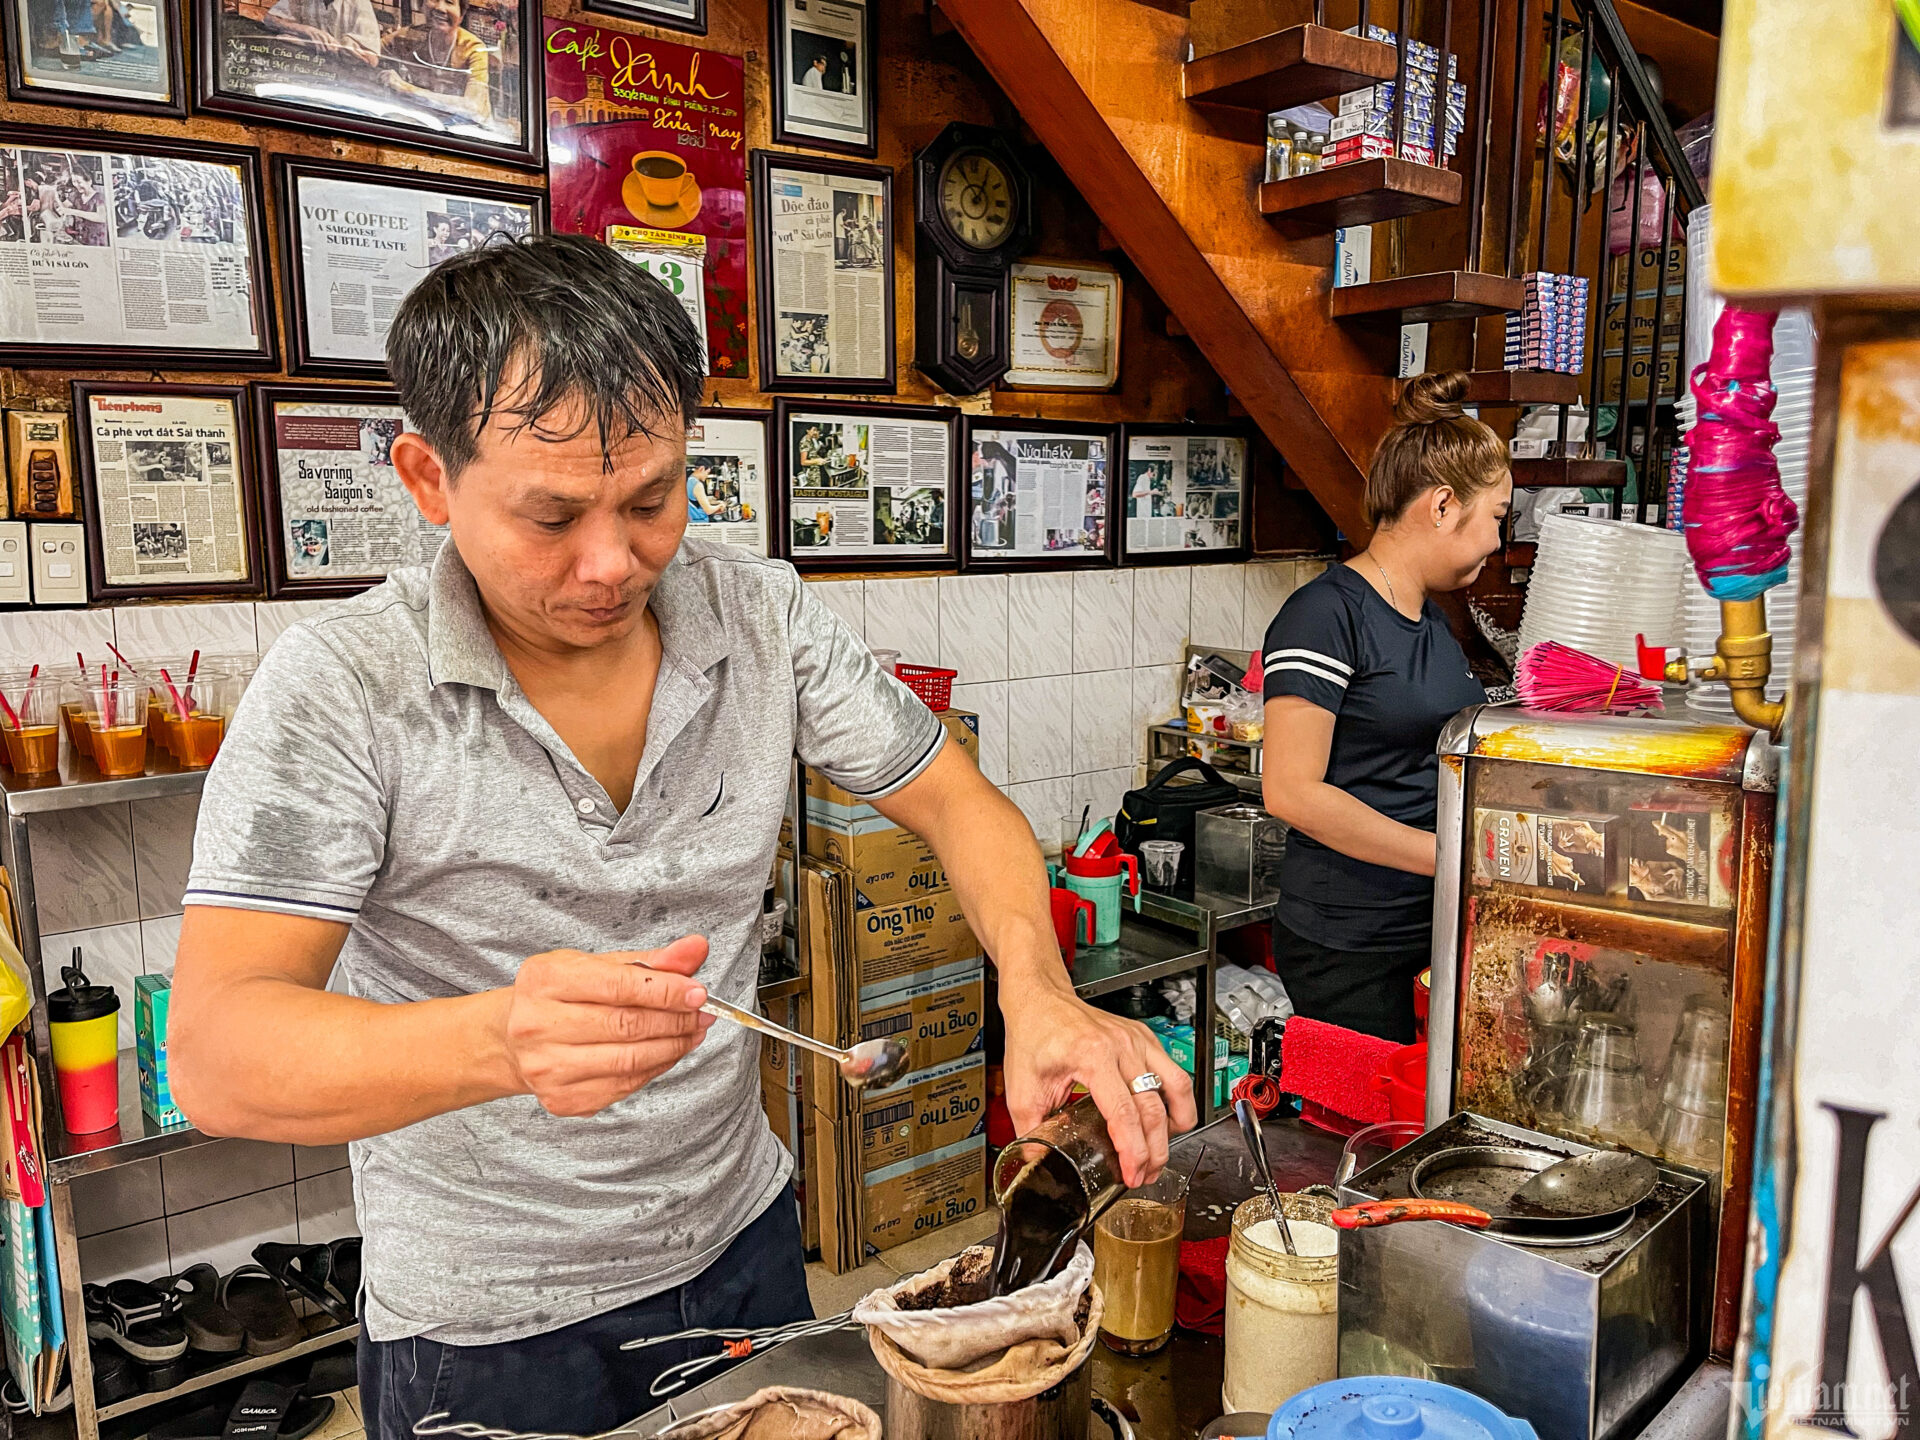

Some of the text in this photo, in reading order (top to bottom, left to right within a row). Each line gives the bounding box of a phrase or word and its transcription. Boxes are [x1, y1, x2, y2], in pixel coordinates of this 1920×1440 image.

[546, 27, 606, 71] Café
[326, 224, 377, 237] SAIGONESE
[344, 211, 409, 230] COFFEE
[326, 235, 407, 251] SUBTLE TASTE
[298, 459, 354, 485] Savoring
[324, 480, 374, 504] Saigon's
[817, 489, 827, 497] OF
[828, 490, 867, 498] NOSTALGIA
[306, 505, 384, 513] old fashioned coffee
[1499, 817, 1510, 877] CRAVEN
[881, 871, 895, 881] CAO
[867, 904, 935, 936] Ông Thọ
[919, 1009, 977, 1039] Ông Thọ
[920, 1095, 980, 1125] Ông Thọ
[914, 1197, 977, 1230] Ông Thọ
